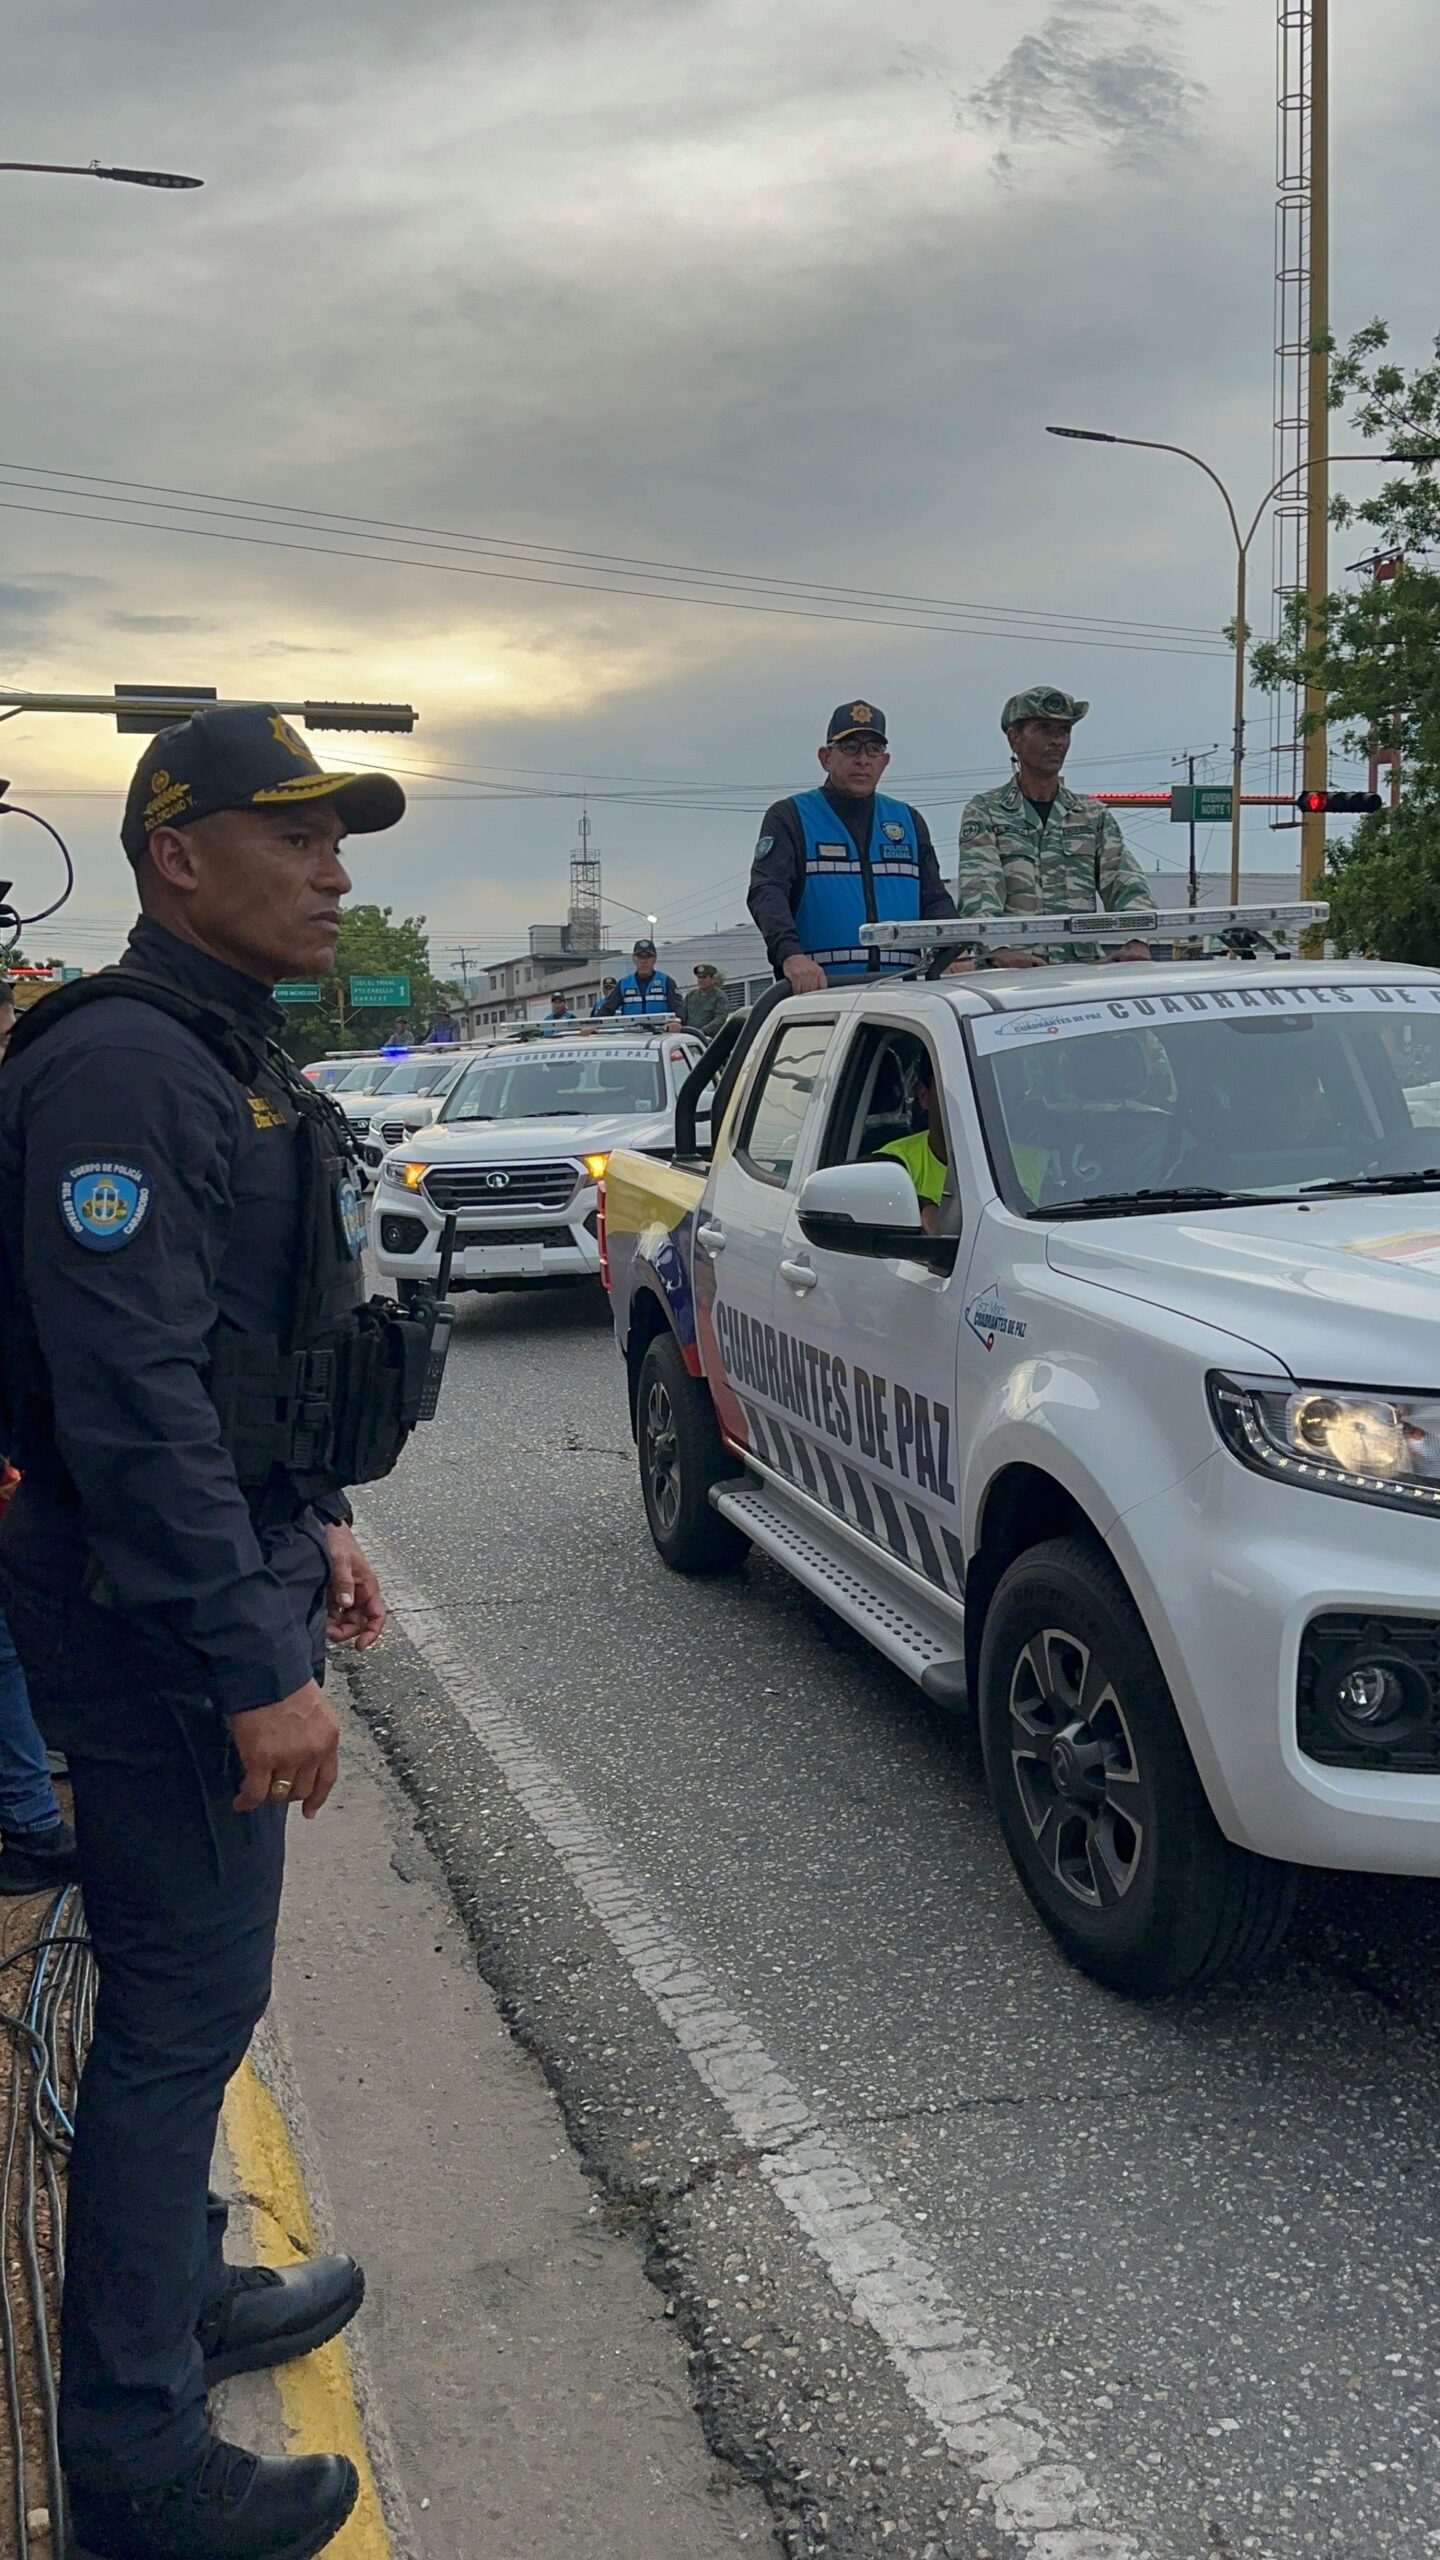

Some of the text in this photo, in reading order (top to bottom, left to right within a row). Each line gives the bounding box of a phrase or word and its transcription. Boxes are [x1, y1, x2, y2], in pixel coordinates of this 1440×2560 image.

[1201, 792, 1231, 803] AVENIDA
[1201, 804, 1225, 815] NORTE
[1106, 987, 1354, 1019] CUADRANTES
[1369, 987, 1417, 1004] DE
[1014, 1016, 1072, 1033] CUADRANTES
[1086, 1012, 1102, 1020] PAZ
[515, 1050, 598, 1062] CUADRANTES
[627, 1050, 650, 1058] PAZ
[70, 1163, 101, 1178] CUERPO
[102, 1163, 112, 1172] DE
[62, 1182, 83, 1233] DEL ESTADO
[123, 1188, 149, 1234] CARABOBO
[974, 1311, 1027, 1338] CUADRANTES DE PAZ
[716, 1300, 956, 1505] CUADRANTES DE PAZ
